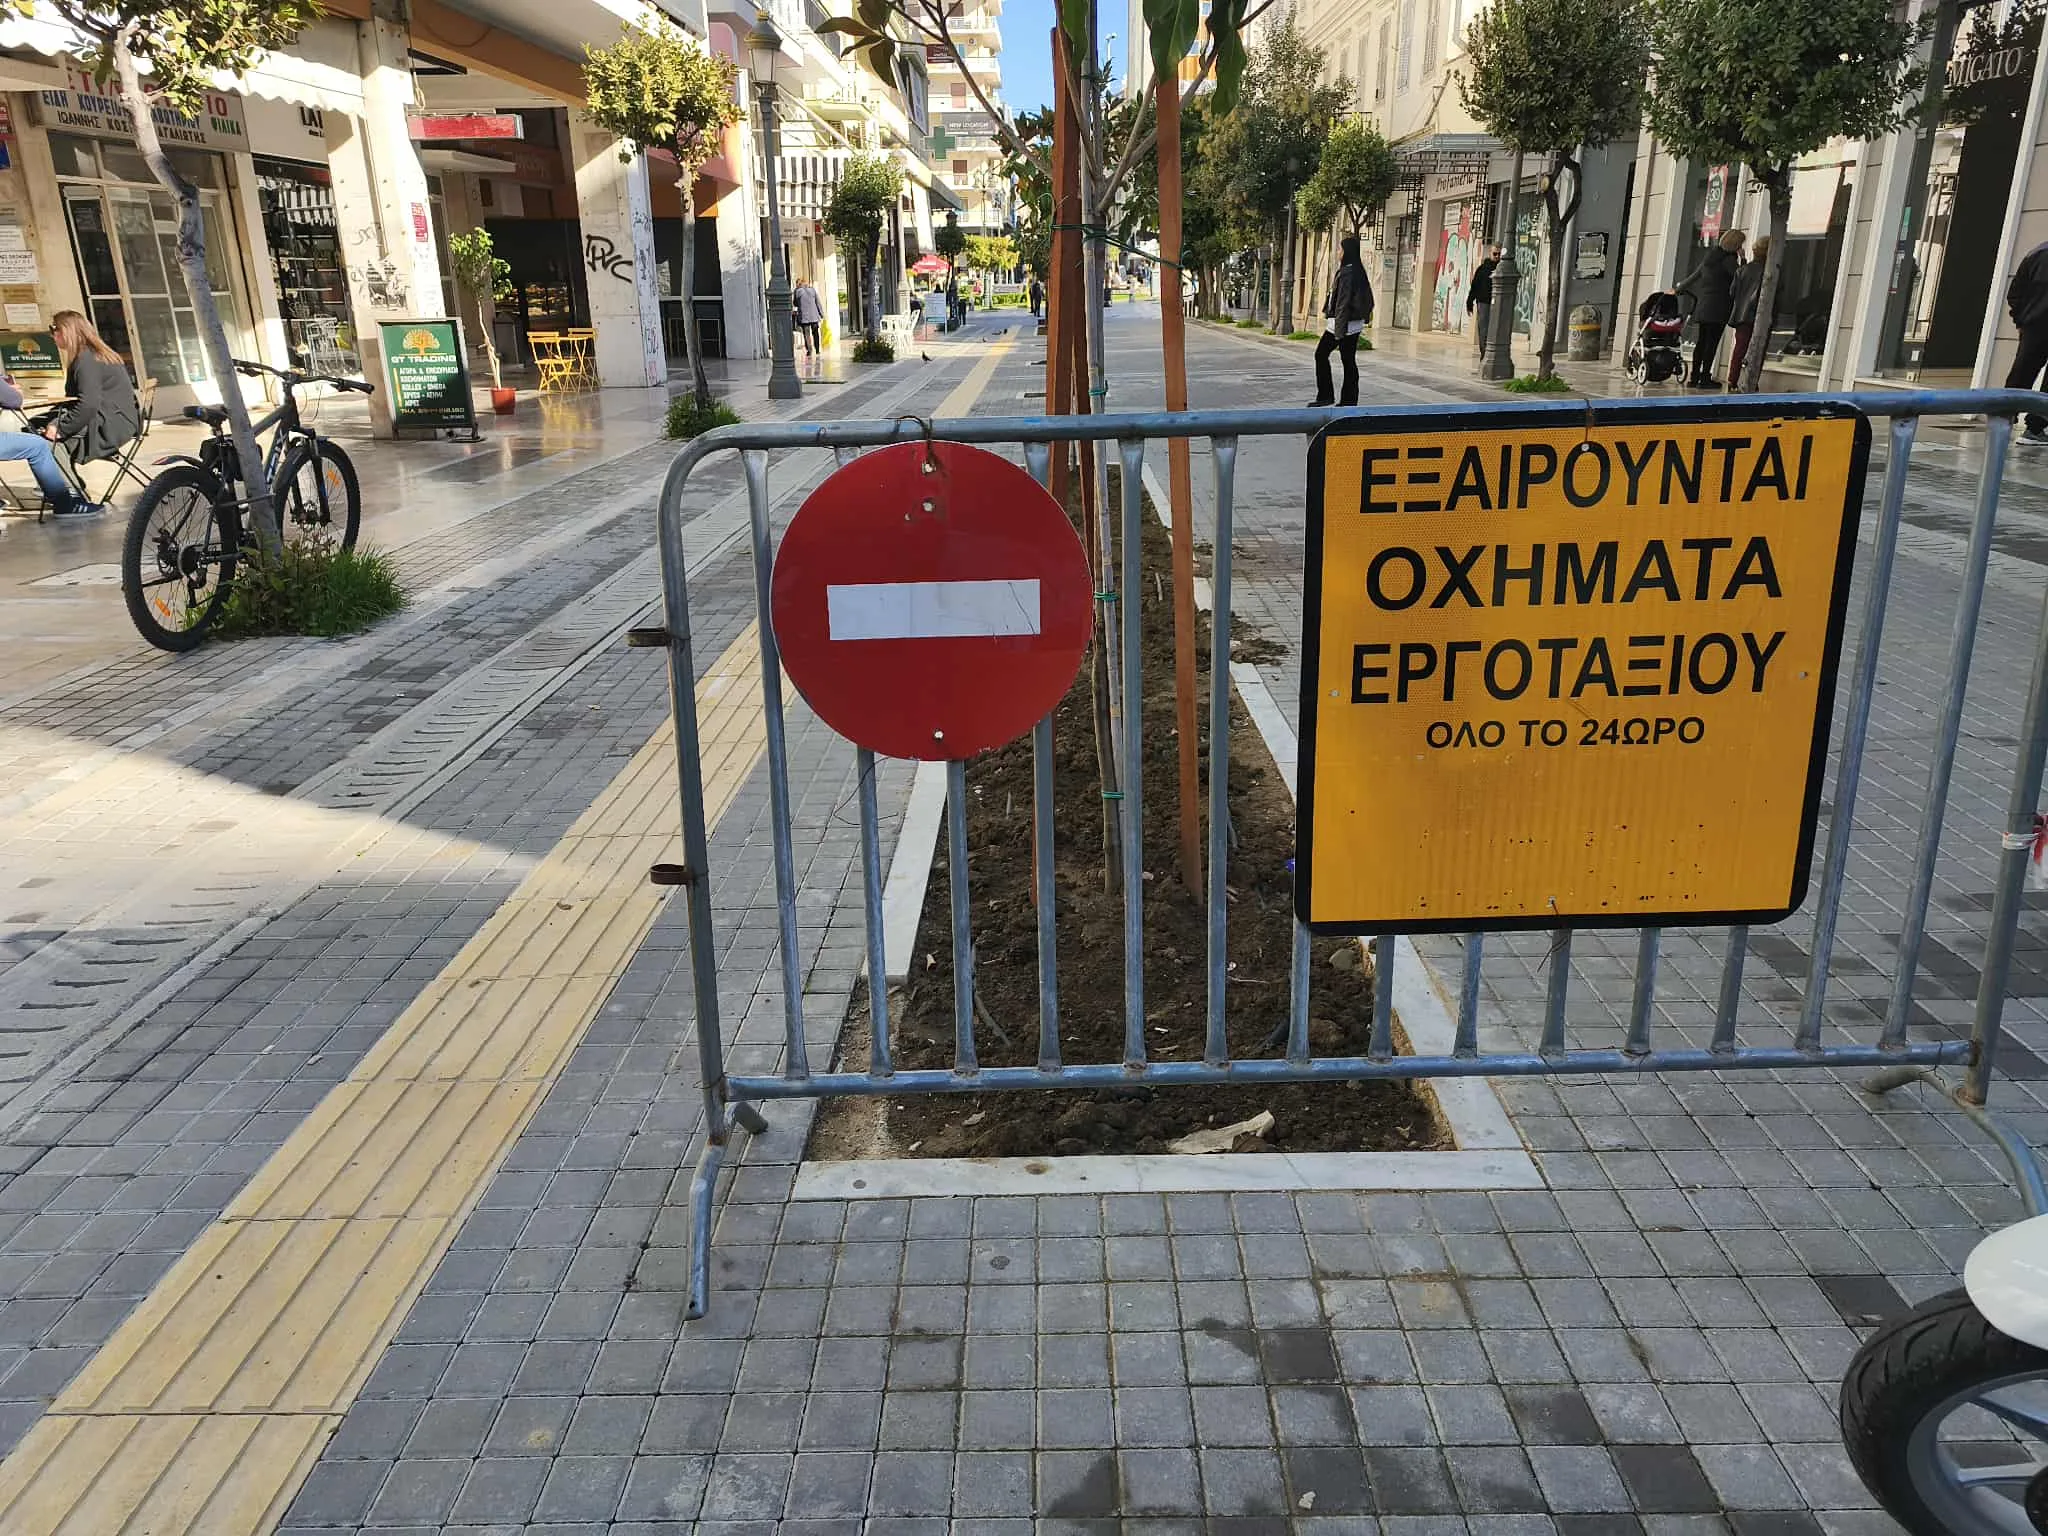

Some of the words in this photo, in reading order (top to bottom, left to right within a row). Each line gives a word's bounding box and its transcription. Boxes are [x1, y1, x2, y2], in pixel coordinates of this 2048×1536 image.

[407, 355, 457, 363] TRADING
[1359, 435, 1813, 513] ΕΞΑΙΡΟΥΝΤΑΙ
[1366, 536, 1782, 610] ΟΧΗΜΑΤΑ
[1351, 631, 1786, 704] ΕΡΓΟΤΑΞΙΟΥ
[1426, 720, 1505, 749] ΟΛΟ
[1518, 719, 1567, 748] ΤΟ
[1579, 716, 1705, 746] 24ΩΡΟ
